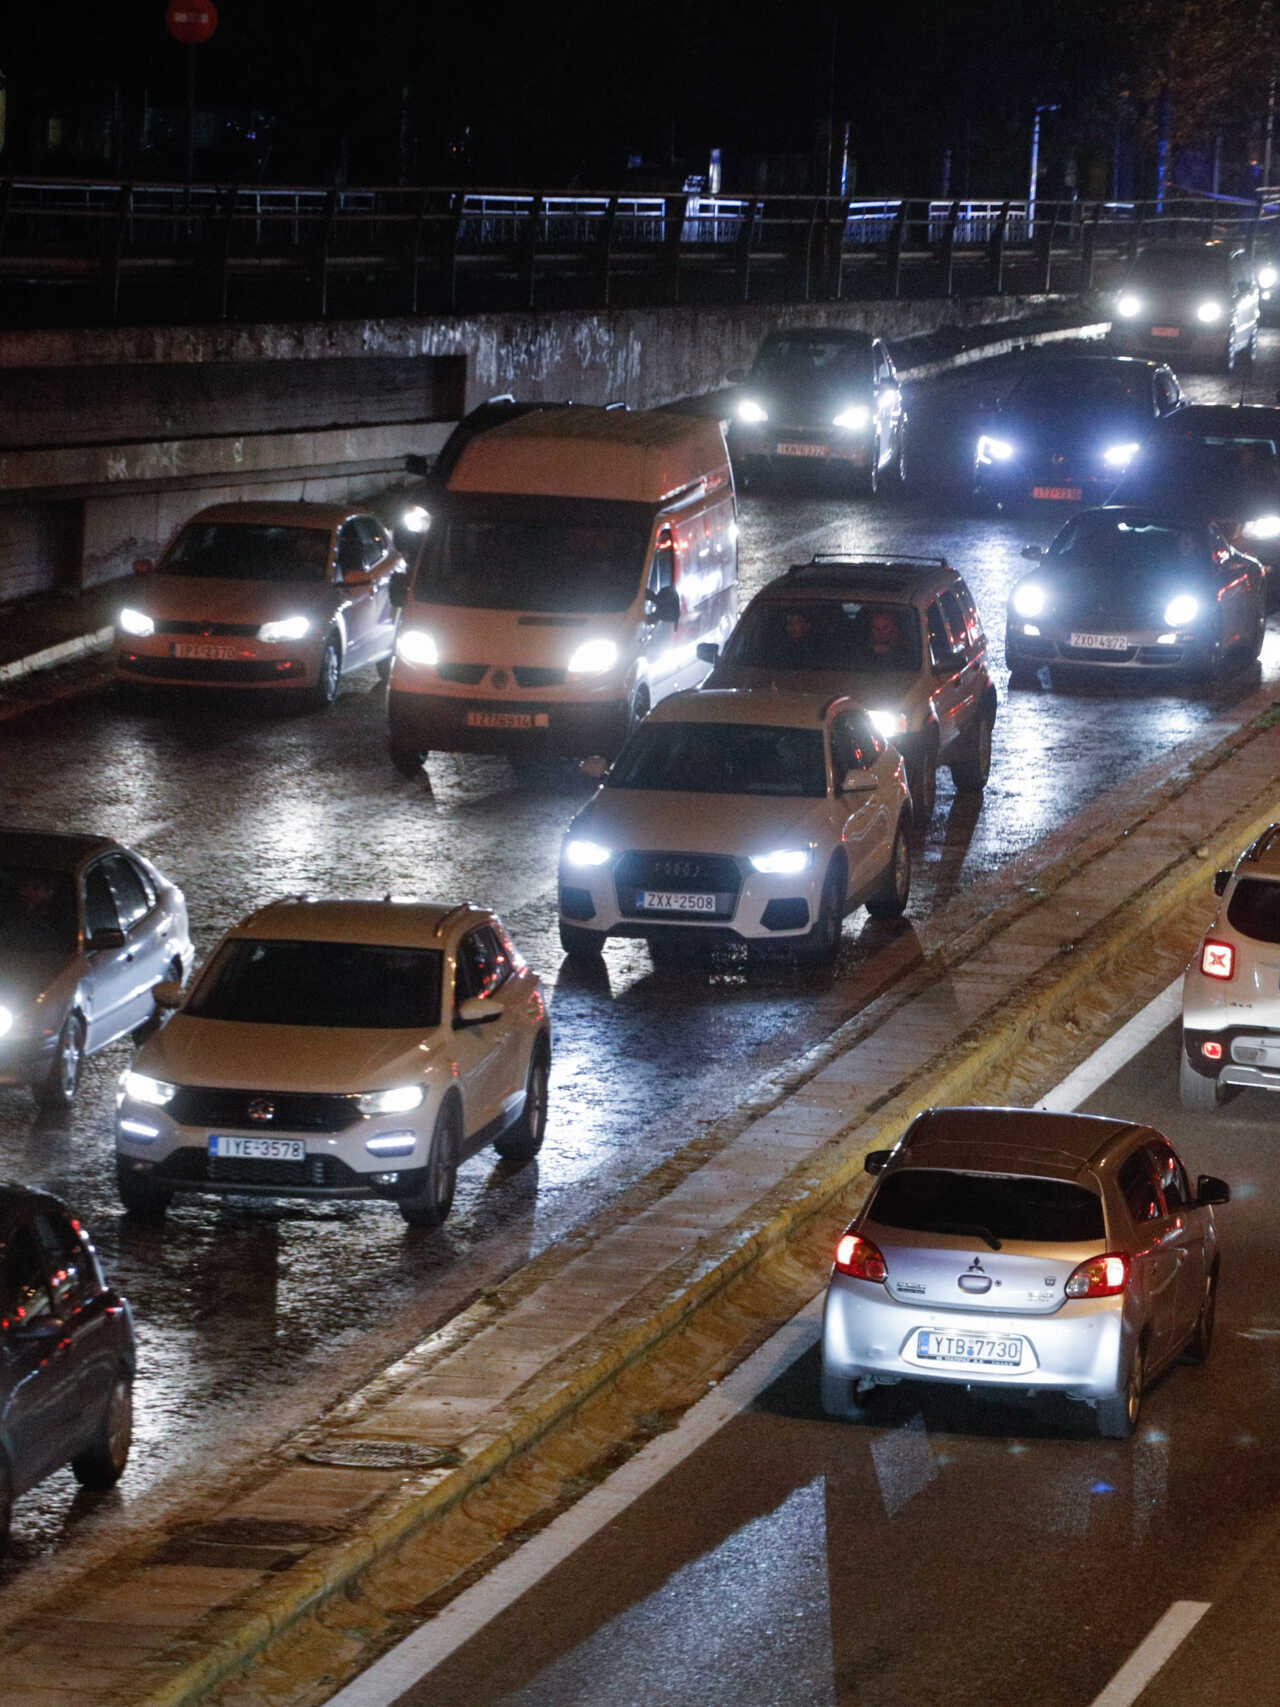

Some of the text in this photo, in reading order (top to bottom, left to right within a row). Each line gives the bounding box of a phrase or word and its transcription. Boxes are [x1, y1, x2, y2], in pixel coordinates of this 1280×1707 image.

[647, 893, 714, 910] ZXX-2508
[225, 1139, 301, 1158] IYE-3578
[934, 1336, 1019, 1359] YTB-7730
